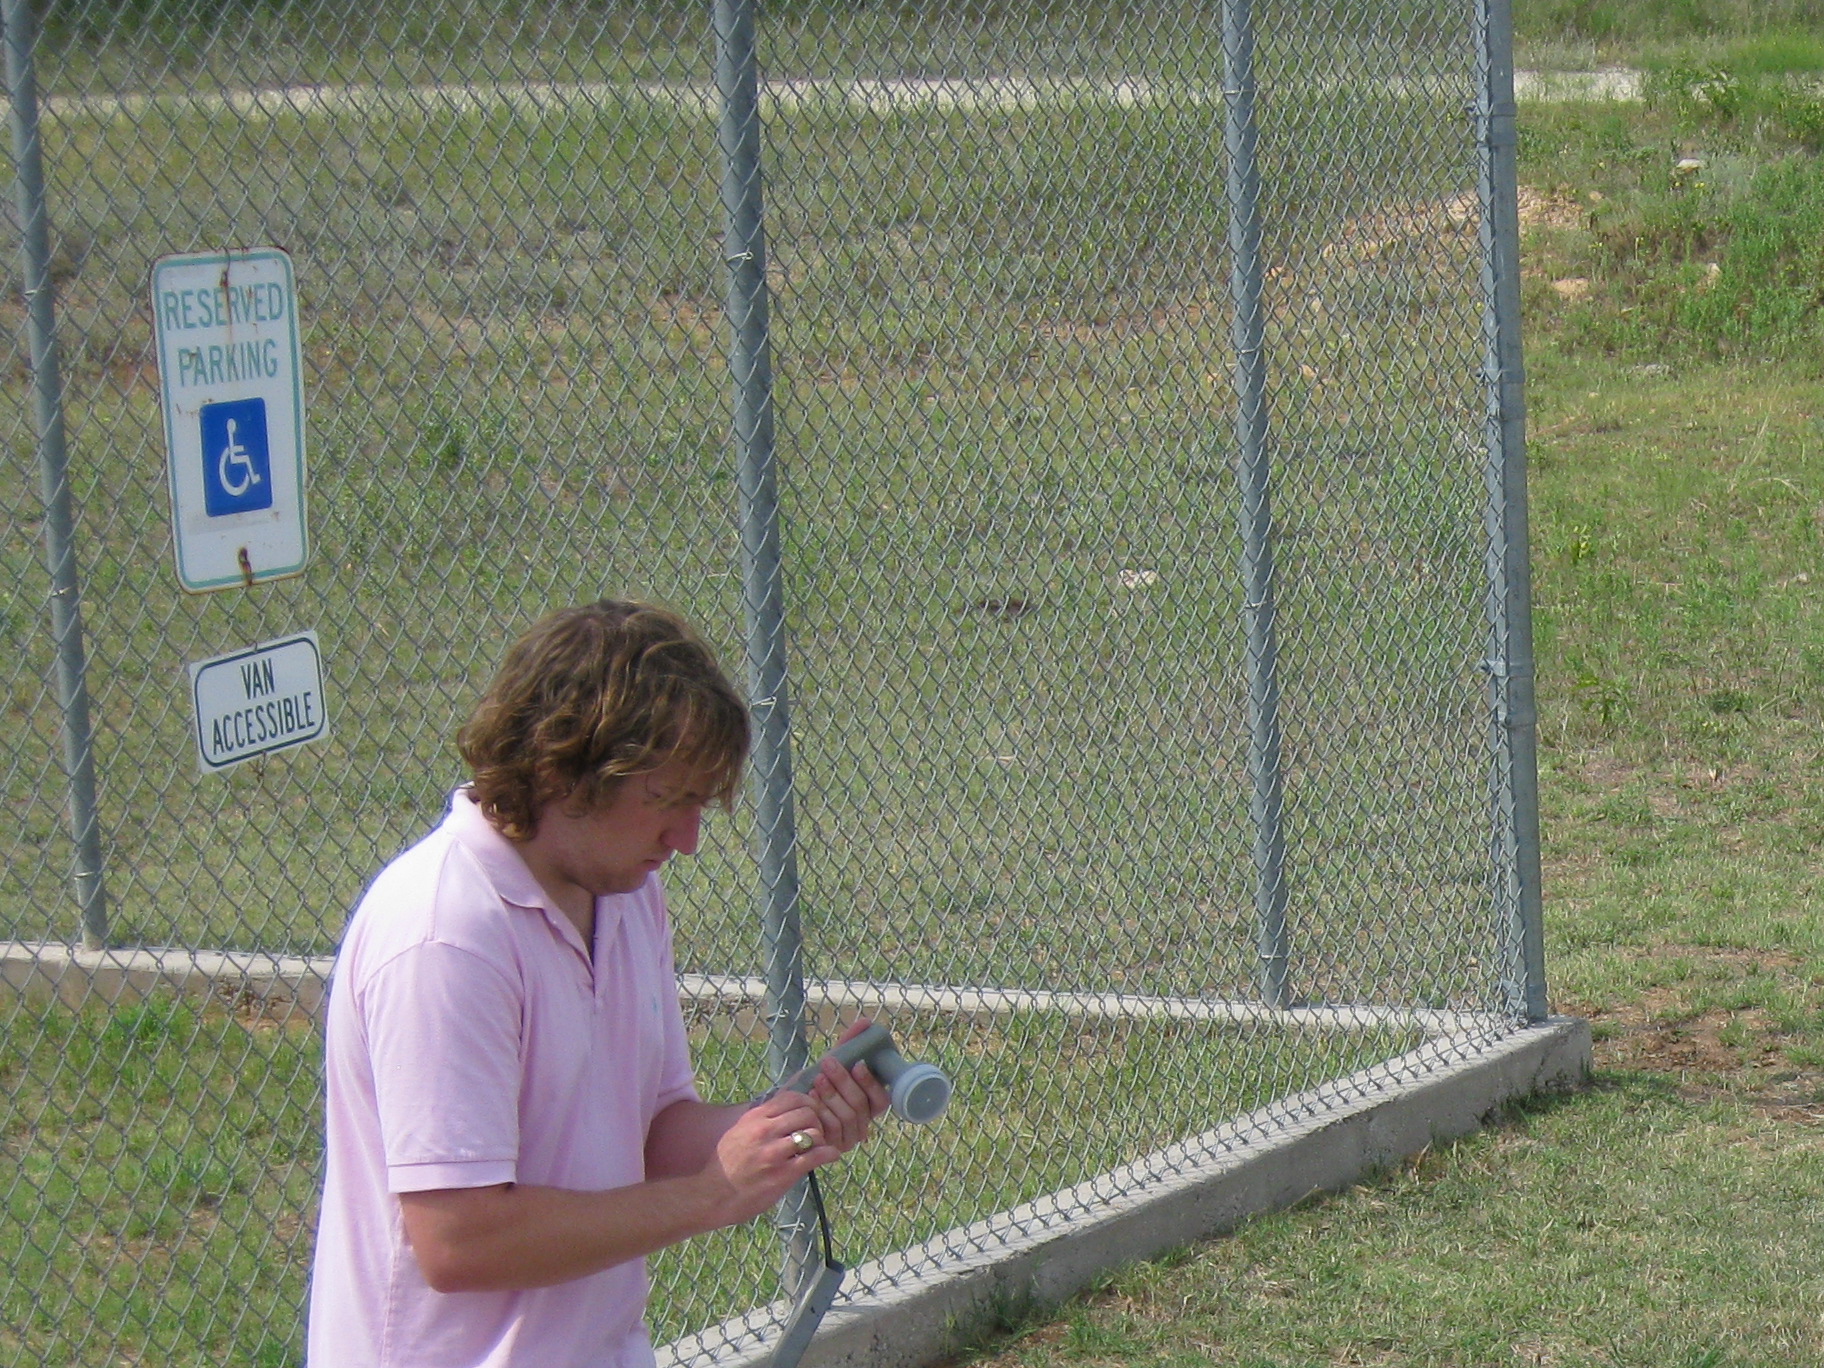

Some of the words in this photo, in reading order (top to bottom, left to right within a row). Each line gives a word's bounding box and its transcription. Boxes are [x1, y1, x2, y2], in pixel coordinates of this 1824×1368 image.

[162, 281, 283, 331] RESERVED
[178, 338, 278, 387] PARKING
[241, 657, 275, 700] VAN
[213, 692, 315, 756] ACCESSIBLE
